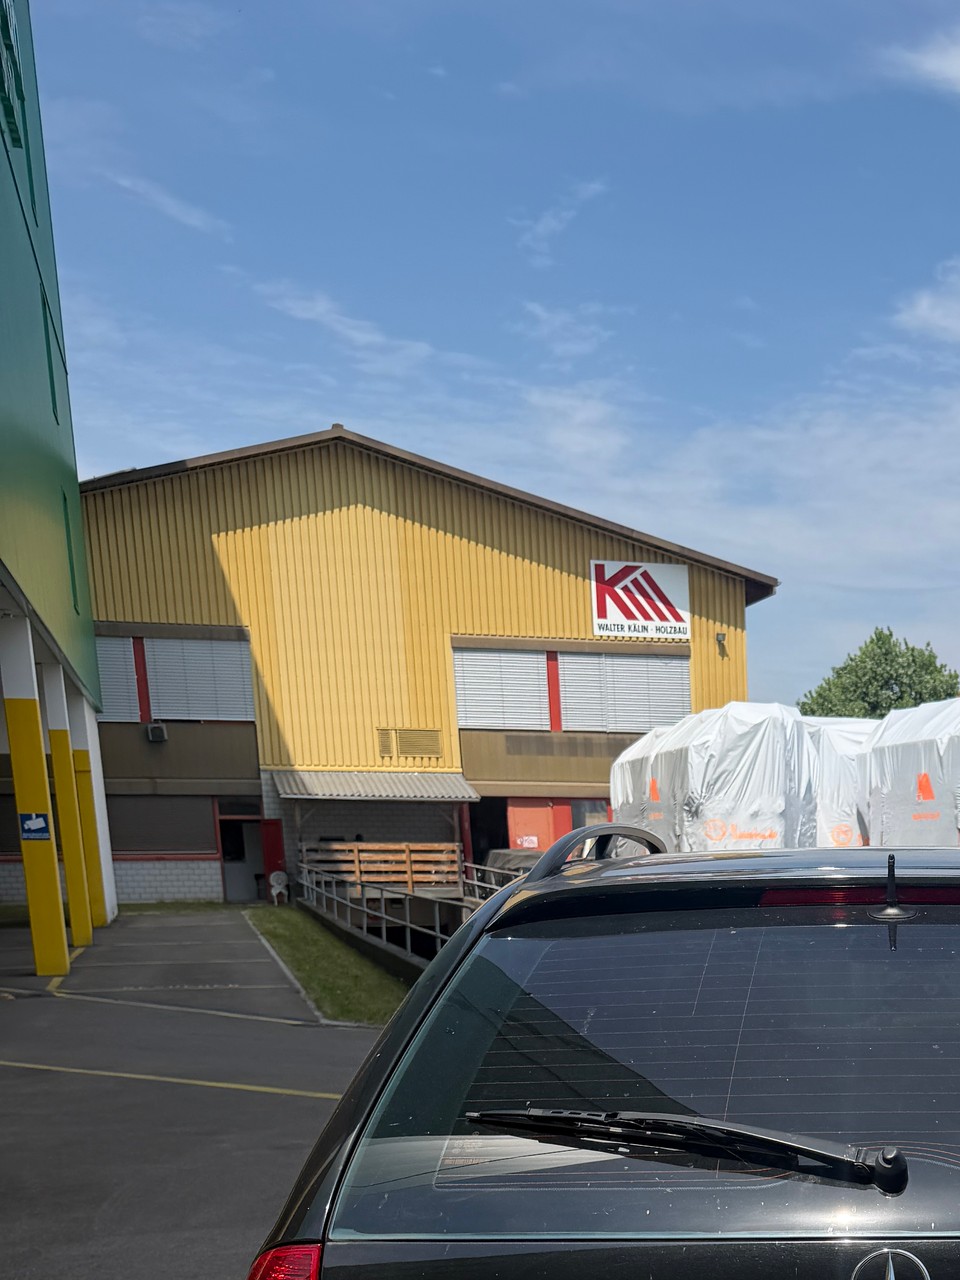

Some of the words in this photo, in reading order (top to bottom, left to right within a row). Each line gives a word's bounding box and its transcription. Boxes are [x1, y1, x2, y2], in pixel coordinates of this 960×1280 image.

[598, 623, 625, 632] WALTER
[628, 623, 649, 633] KÄLIN
[655, 625, 688, 635] HOLZBAU
